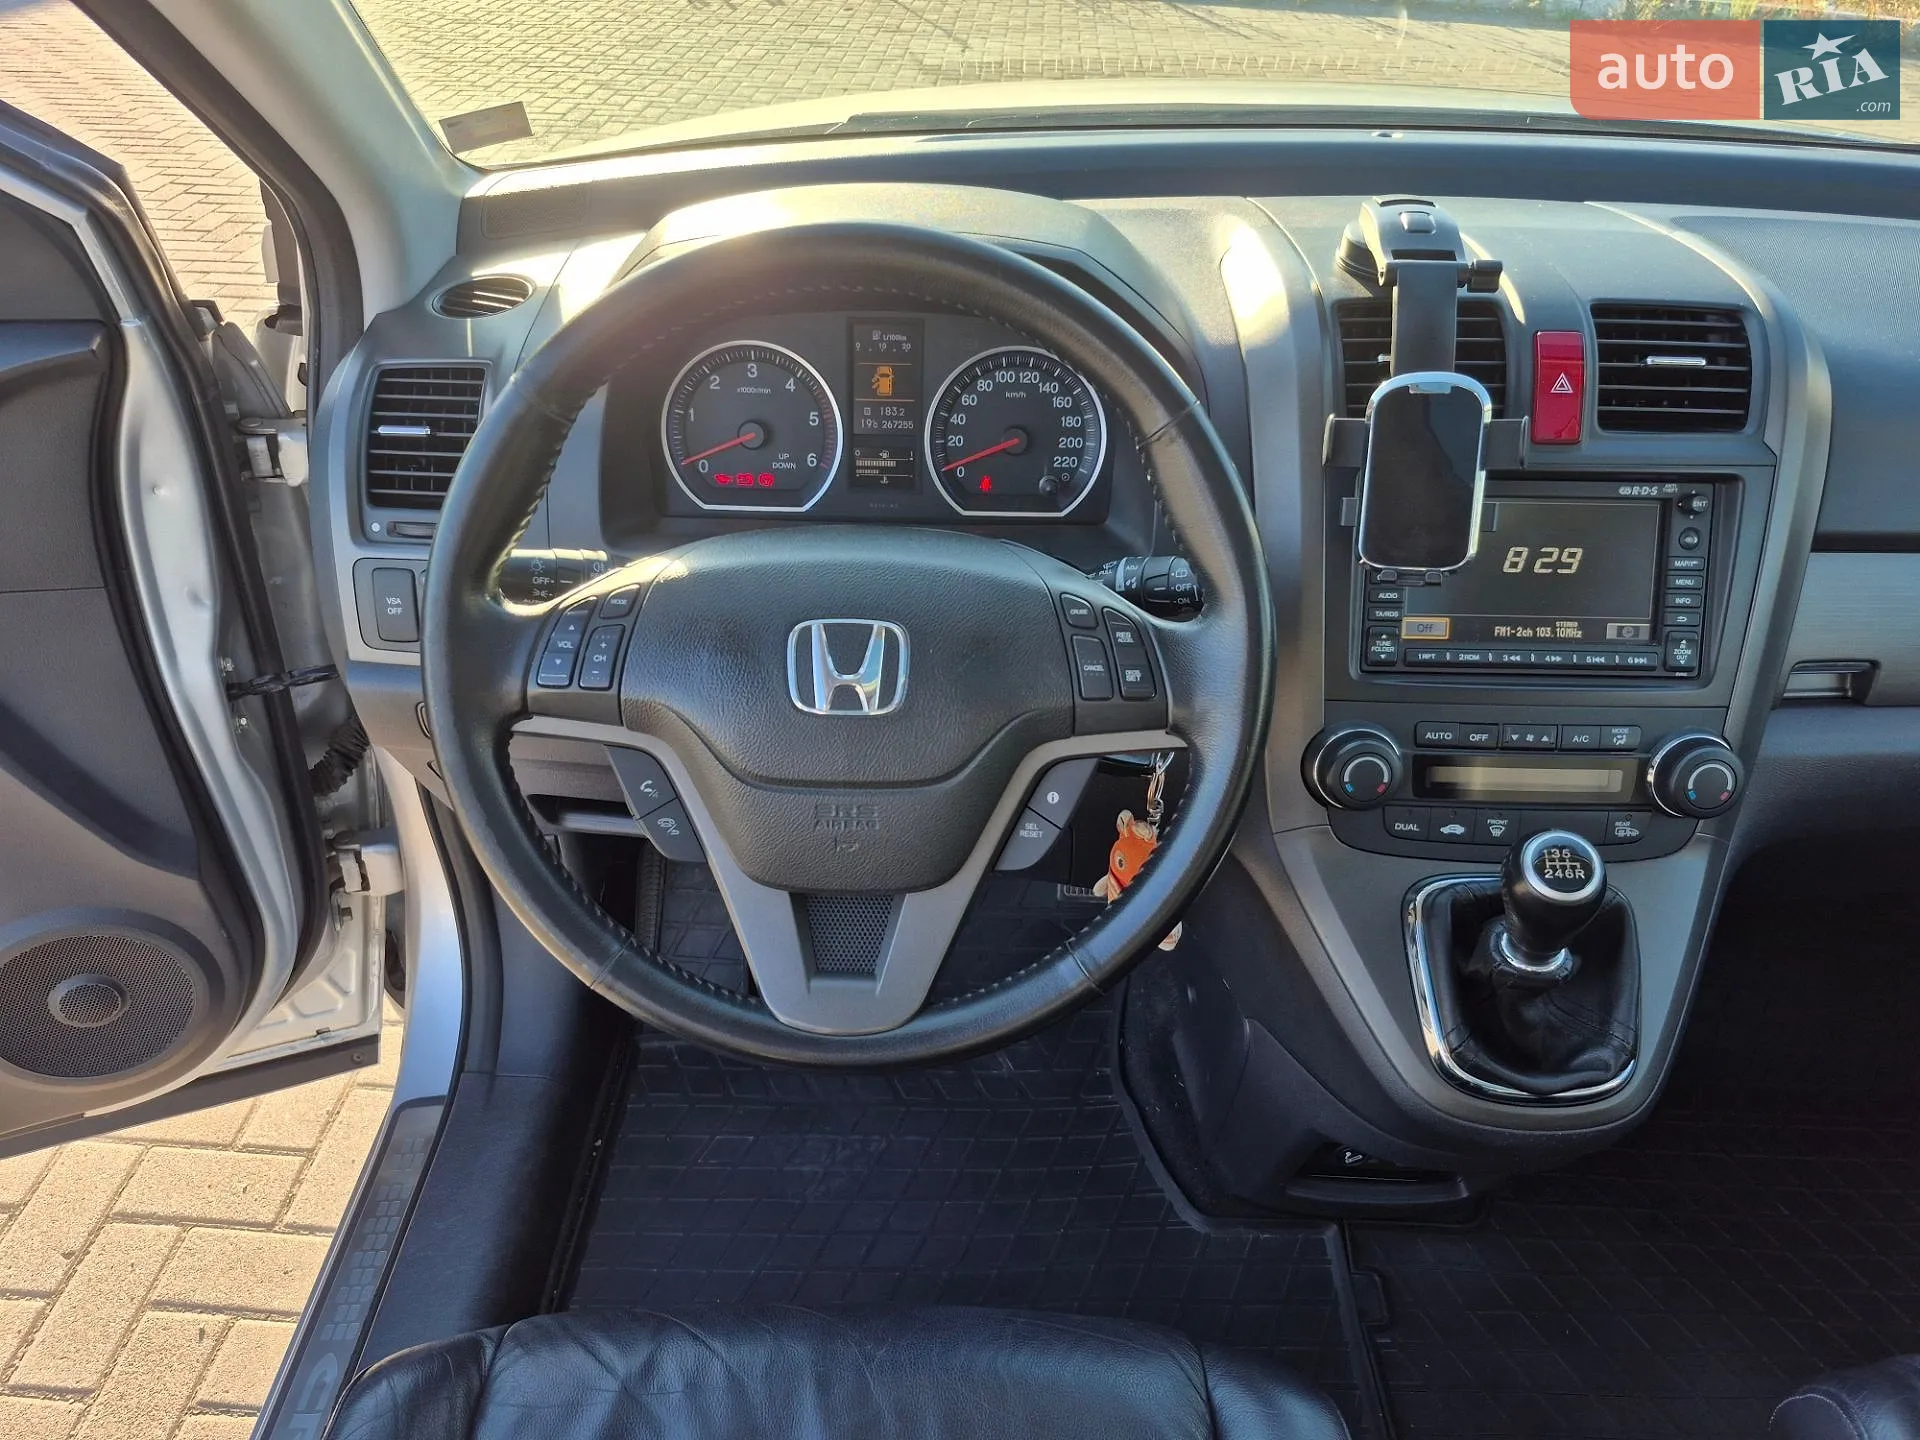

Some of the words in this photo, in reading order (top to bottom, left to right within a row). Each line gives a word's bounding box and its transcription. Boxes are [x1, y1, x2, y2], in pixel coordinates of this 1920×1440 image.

[748, 364, 758, 378] 3
[995, 371, 1015, 383] 100
[710, 376, 720, 390] 2
[1019, 371, 1040, 384] 120
[785, 378, 796, 392] 4
[977, 380, 993, 392] 80
[1038, 382, 1059, 394] 140
[961, 394, 977, 406] 60
[1005, 391, 1026, 399] km/h
[1052, 396, 1072, 409] 160
[688, 408, 695, 422] 1
[809, 412, 819, 426] 5
[950, 413, 966, 425] 40
[1061, 416, 1081, 428] 180
[948, 434, 964, 447] 20
[1058, 437, 1083, 449] 200
[772, 462, 796, 470] DOWN
[806, 453, 817, 467] 6
[1053, 456, 1077, 468] 220
[698, 461, 709, 473] 0
[957, 466, 965, 478] 0
[1675, 578, 1694, 586] MENU
[386, 597, 402, 605] VSA
[1378, 591, 1398, 599] AUDIO
[1675, 597, 1691, 605] INFO
[388, 608, 402, 616] OFF
[1417, 624, 1434, 632] Off
[1425, 731, 1452, 740] AUTO
[1469, 733, 1488, 741] OFF
[1572, 735, 1589, 743] A/C
[1394, 822, 1420, 831] DUAL
[1020, 830, 1042, 838] RESET
